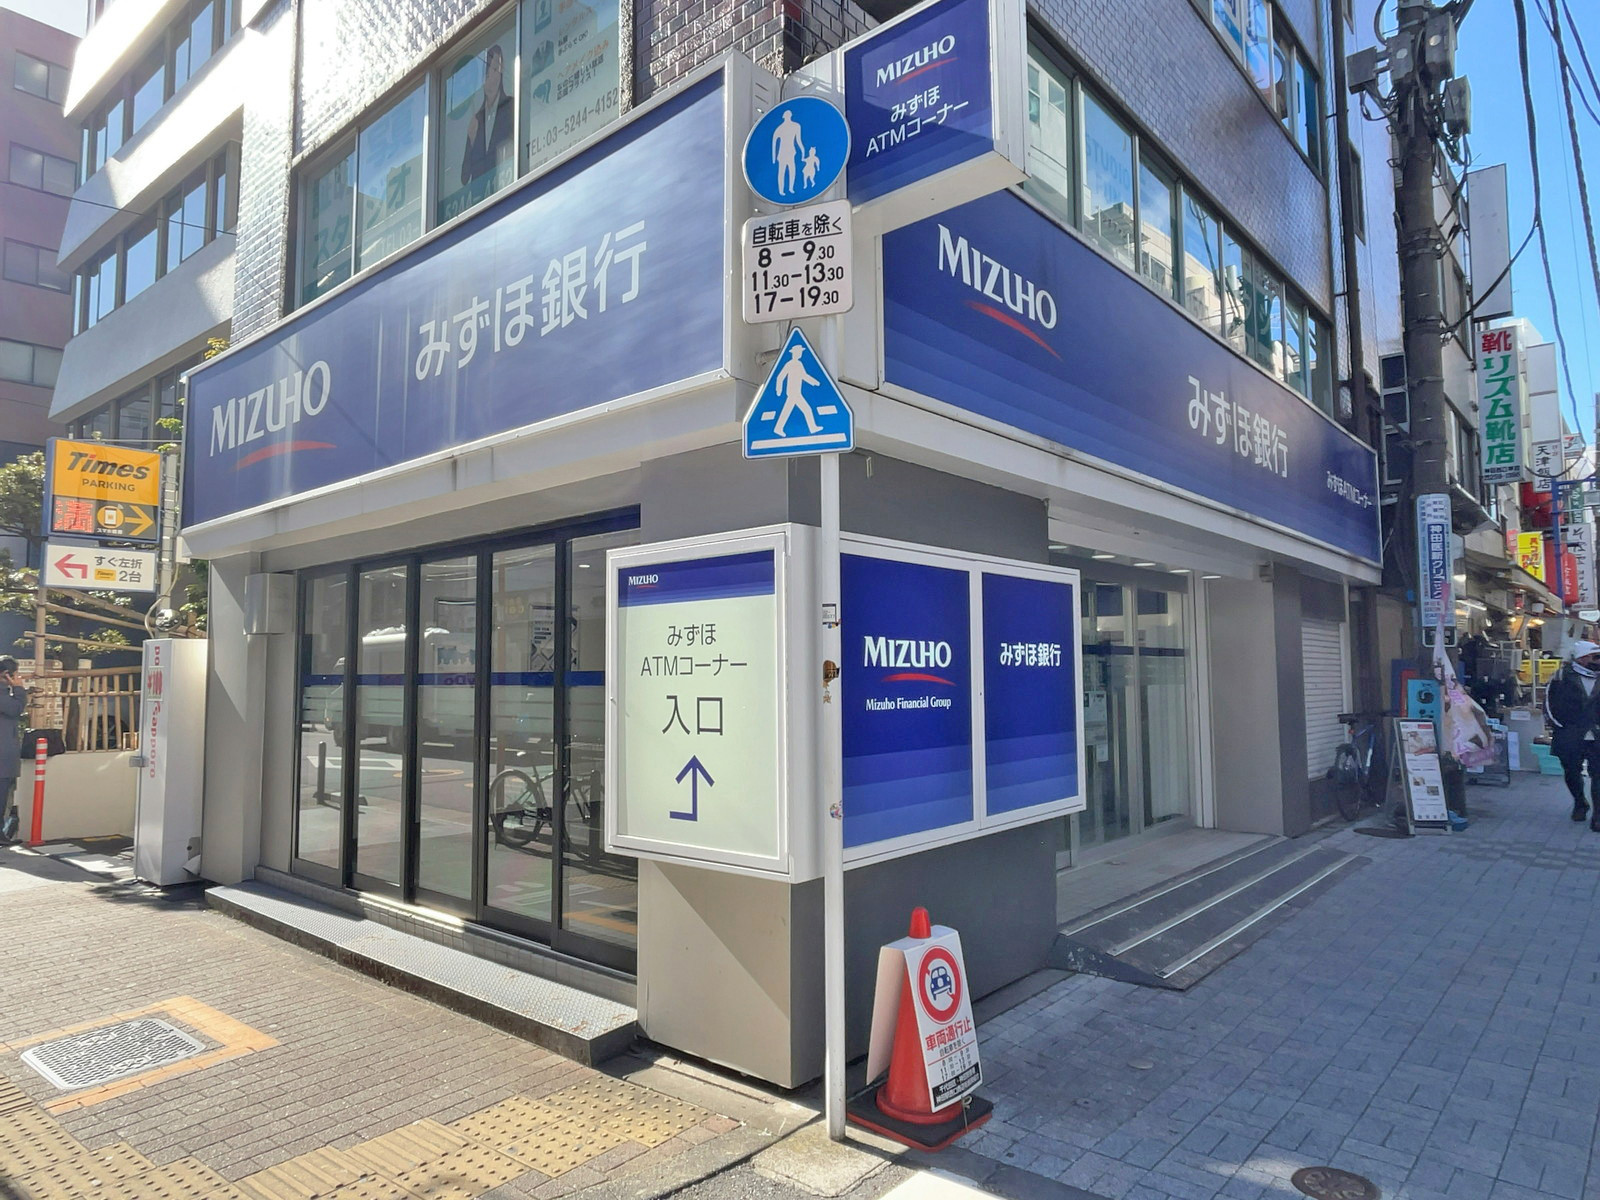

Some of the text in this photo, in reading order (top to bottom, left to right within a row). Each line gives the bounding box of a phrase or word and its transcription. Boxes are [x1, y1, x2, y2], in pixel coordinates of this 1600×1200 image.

[876, 35, 955, 87] MIZUHO
[891, 85, 940, 122] みずほ
[866, 101, 968, 157] ATMコーナー
[753, 214, 842, 244] 自転車を除く
[938, 223, 1057, 330] MIZUHO
[415, 220, 647, 381] みずほ銀行
[1482, 330, 1512, 353] 靴
[209, 360, 331, 458] MIZUHO
[1483, 354, 1516, 465] リズム靴店
[1188, 375, 1289, 479] みずほ銀行
[67, 452, 150, 480] Times
[82, 479, 136, 492] PARKING
[53, 500, 94, 534] 満
[94, 556, 143, 569] すぐ左折
[118, 570, 142, 583] 2台
[628, 574, 659, 586] MIZUHO
[667, 623, 717, 647] みずほ
[640, 653, 748, 677] ATMコーナー
[863, 636, 952, 668] MIZUHO
[1000, 642, 1061, 667] みずほ銀行
[662, 695, 724, 736] 入口
[865, 696, 952, 711] Mizuho Financial Group
[925, 1017, 972, 1051] 車両通行止
